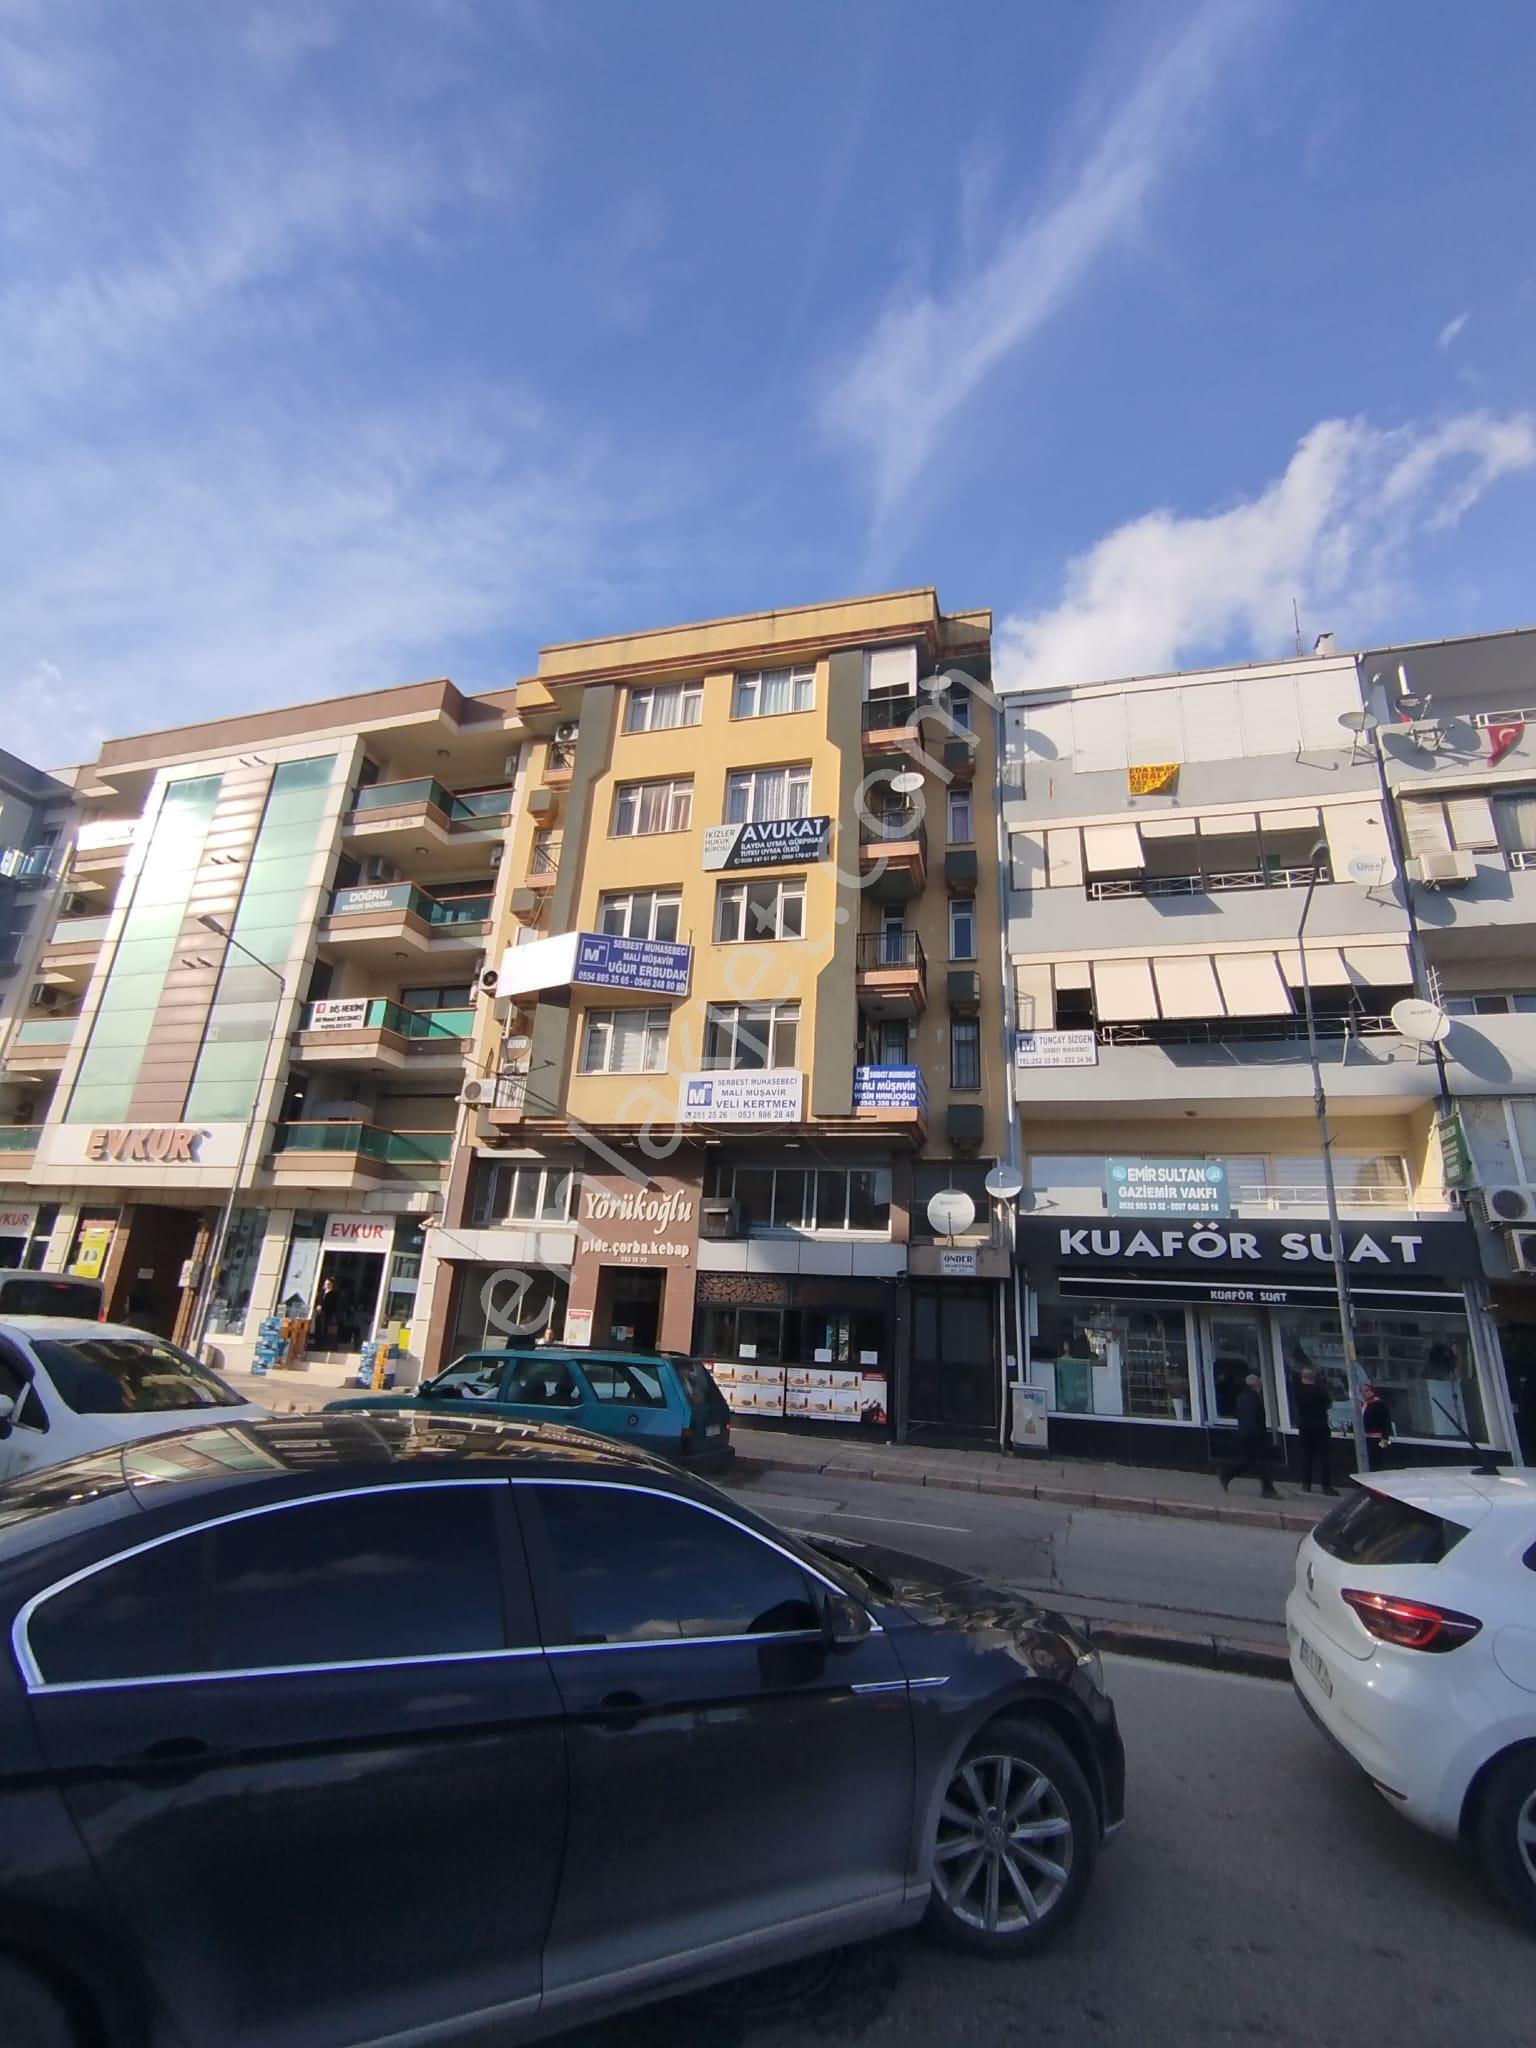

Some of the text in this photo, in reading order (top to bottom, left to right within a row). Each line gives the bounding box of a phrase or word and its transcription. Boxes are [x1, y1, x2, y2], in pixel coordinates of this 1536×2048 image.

[705, 829, 736, 839] İKİZLER
[741, 818, 824, 842] AVUKAT
[704, 838, 730, 847] HUKUK
[740, 841, 766, 851] İLAYDA
[766, 839, 787, 849] UYMA
[760, 848, 781, 856] UYMA
[350, 888, 388, 902] DOĞRU
[613, 939, 688, 956] SERBEST MUHASEBECİ
[623, 951, 674, 967] MALİ MÜŞAVİR
[608, 960, 687, 981] UĞUR ERBUDAK
[610, 974, 619, 984] 35
[1040, 1033, 1092, 1045] TUNCAY SİZGEN
[717, 1077, 798, 1086] SERBEST MUHASEBECİ
[854, 1080, 876, 1091] MALİ
[721, 1088, 743, 1096] MALİ
[716, 1098, 797, 1108] VELİ KERTMEN
[692, 1111, 706, 1119] 251
[708, 1111, 717, 1119] 25
[719, 1111, 728, 1119] 26
[738, 1111, 756, 1119] 0531
[84, 1128, 195, 1161] EVKUR
[1127, 1165, 1206, 1182] EMİR SULTAN
[1118, 1184, 1218, 1199] GAZİEMİR VAKFI
[584, 1188, 693, 1235] Yörükoğlu
[330, 1222, 385, 1240] EVKUR
[1059, 1221, 1423, 1264] KUAFÖR SUAT
[944, 1254, 973, 1263] ÖNDER
[1210, 1289, 1287, 1302] KUAFÖR SUAT
